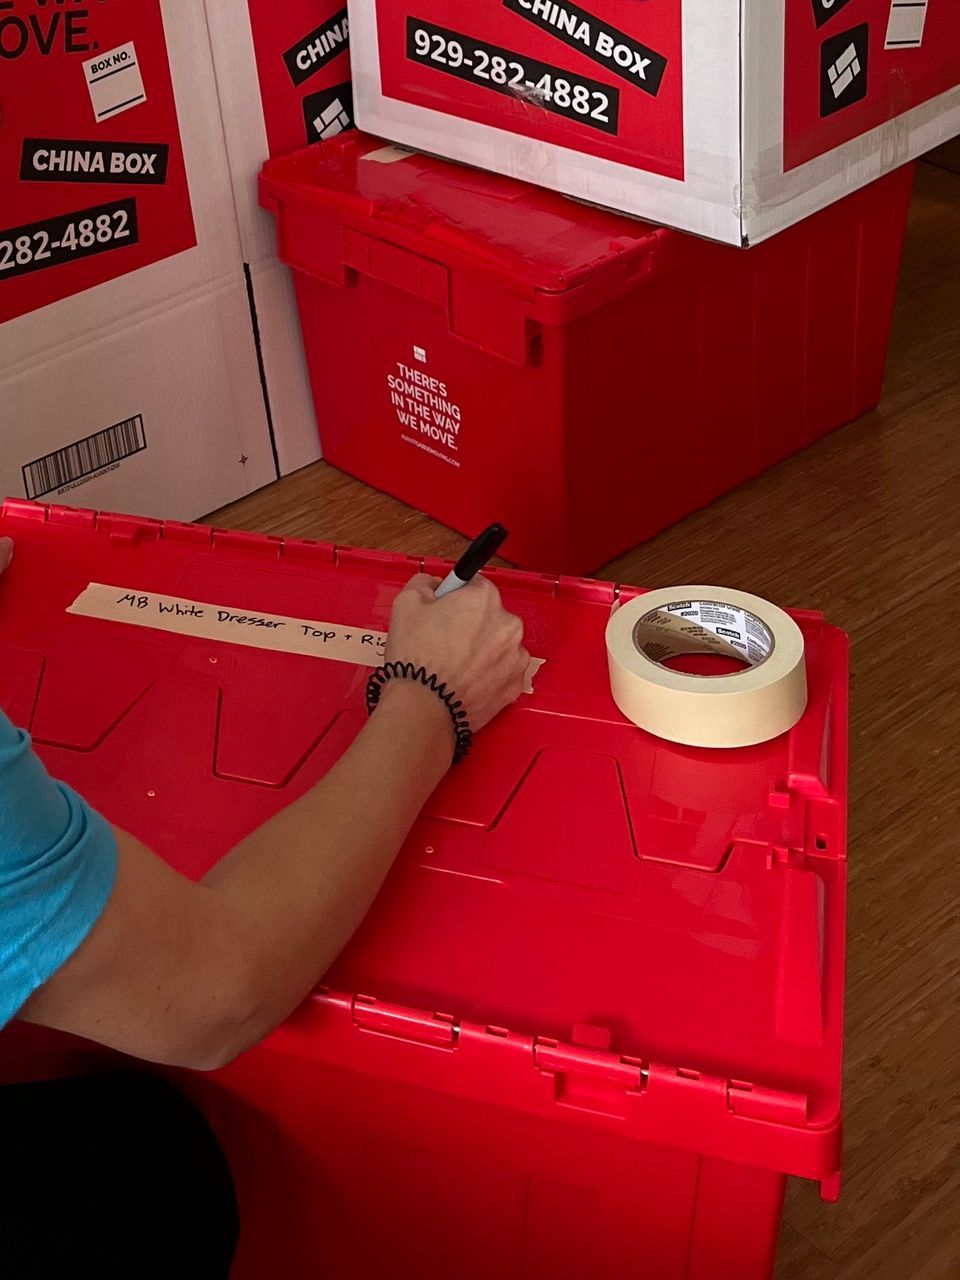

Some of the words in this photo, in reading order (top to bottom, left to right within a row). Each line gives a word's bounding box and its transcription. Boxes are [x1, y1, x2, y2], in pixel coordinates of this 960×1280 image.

[90, 56, 113, 75] BOX
[112, 50, 131, 67] NO.
[413, 28, 609, 123] 929-282-4882
[595, 32, 652, 81] BOX
[32, 149, 105, 173] CHINA
[109, 152, 158, 175] BOX
[387, 374, 461, 422] SOMETHING
[396, 361, 448, 398] THERE'S
[391, 390, 405, 409] IN
[406, 397, 431, 422] THE
[431, 409, 461, 436] WAY
[396, 407, 418, 431] WE
[419, 419, 458, 451] MOVE.
[116, 593, 149, 610] MB
[158, 601, 204, 618] White
[217, 609, 286, 630] Dresser
[301, 624, 336, 643] Top
[717, 627, 740, 639] Scotch
